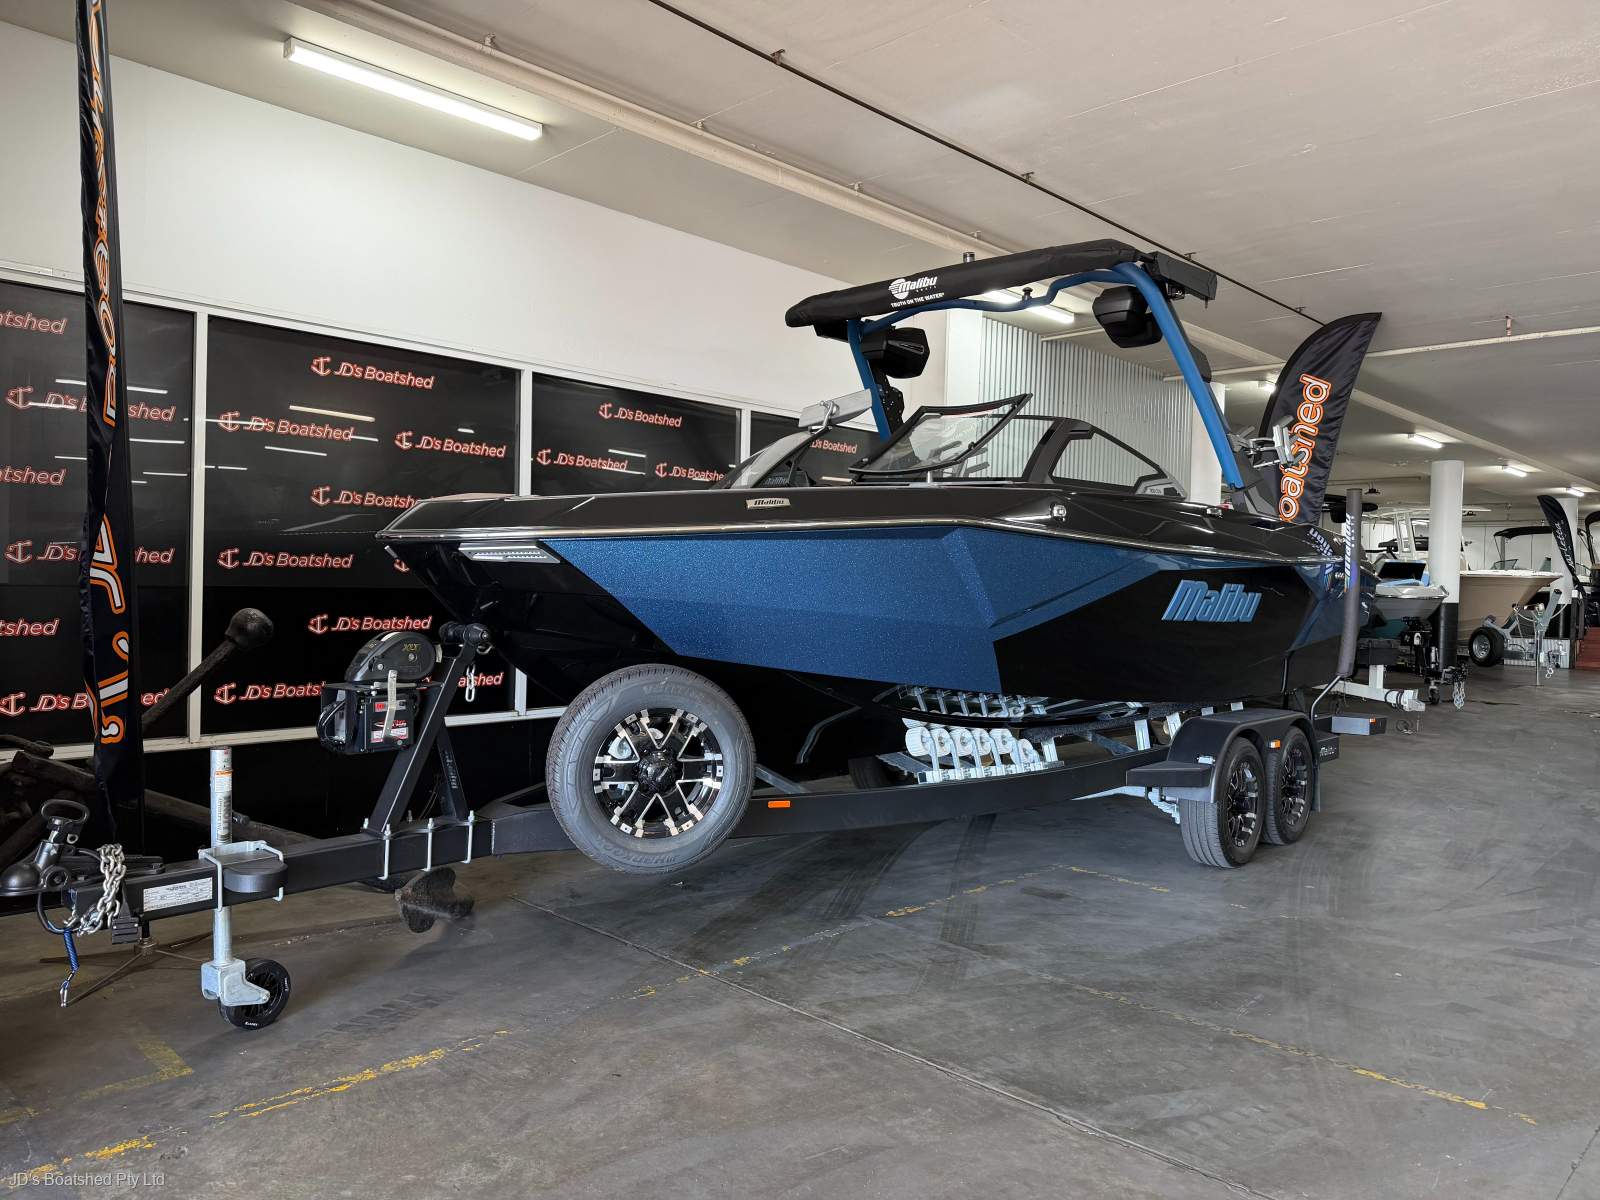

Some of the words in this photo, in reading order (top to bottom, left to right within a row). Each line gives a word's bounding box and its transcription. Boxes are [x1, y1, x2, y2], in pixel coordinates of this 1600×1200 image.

[898, 276, 938, 293] Malibu
[335, 361, 363, 378] JD's
[364, 366, 434, 389] Boatshed
[614, 407, 633, 421] JD's
[634, 410, 683, 429] Boatshed
[244, 417, 274, 432] JD's
[276, 420, 354, 442] Boatshed
[415, 435, 442, 451] JD's
[443, 439, 506, 459] Boatshed
[823, 440, 858, 454] Boatshed
[553, 453, 574, 467] JD's
[575, 455, 628, 472] Boatshed
[687, 468, 726, 481] Boatshe
[334, 490, 361, 504] JD's
[37, 544, 79, 561] JD's
[244, 552, 273, 567] JD's
[276, 553, 354, 569] Boatshed
[1161, 579, 1262, 623] Malibu
[331, 617, 360, 633] JD's
[361, 616, 433, 632] Boatshed
[239, 685, 272, 701] JD's
[29, 693, 71, 712] JD's
